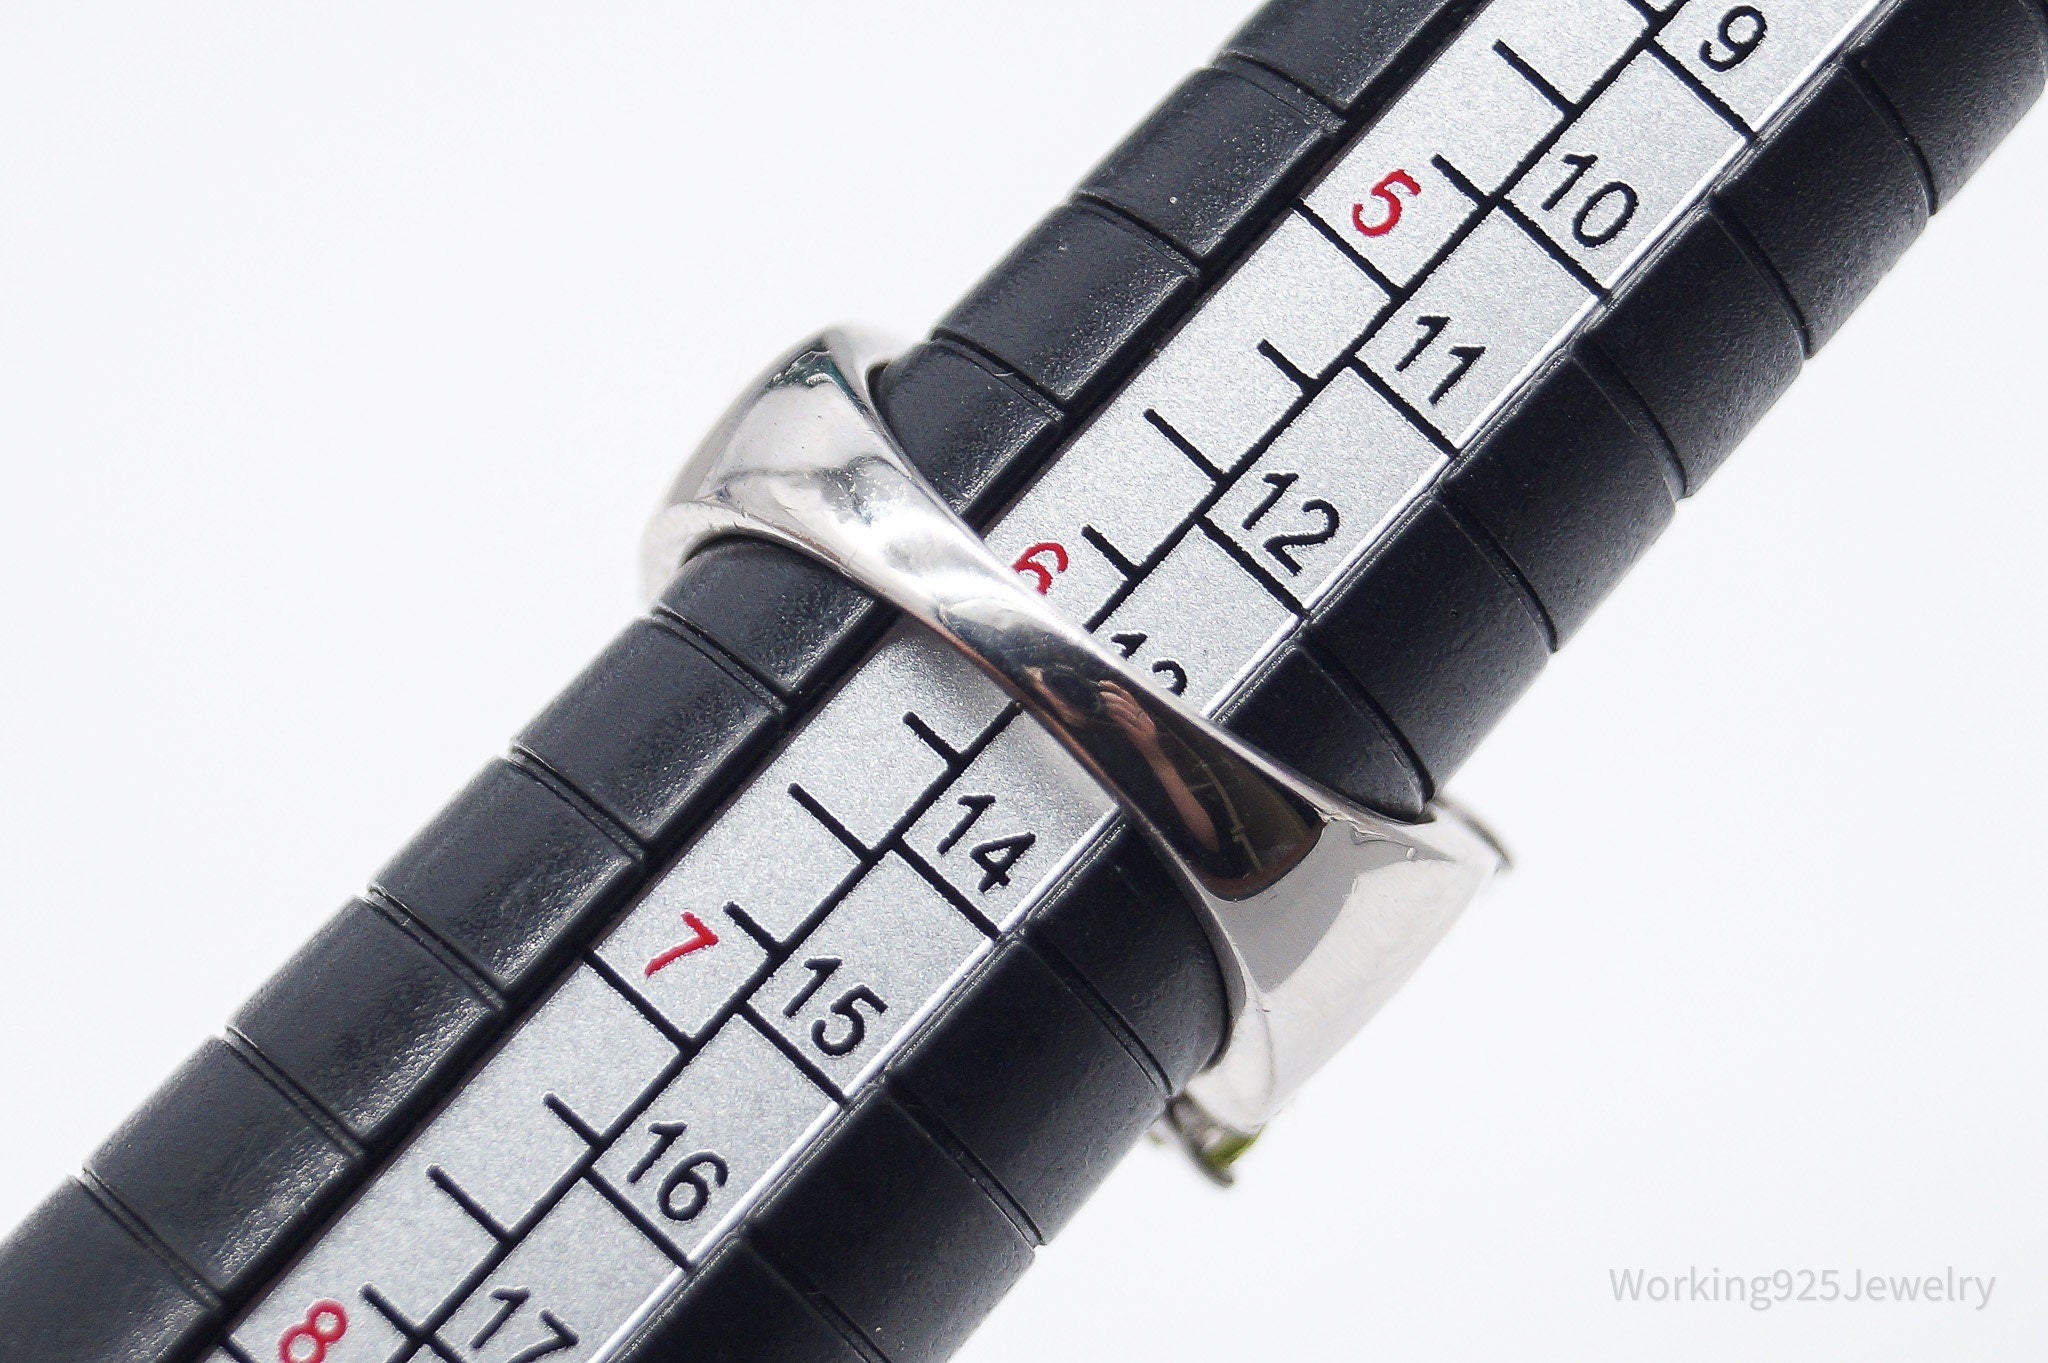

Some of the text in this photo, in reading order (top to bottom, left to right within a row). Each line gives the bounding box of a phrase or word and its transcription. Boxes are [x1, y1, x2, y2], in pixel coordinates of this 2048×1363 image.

[1698, 4, 1769, 74] 9
[1351, 168, 1423, 238] 5
[1540, 152, 1641, 250] 10
[1394, 314, 1487, 408] 11
[1240, 471, 1342, 579] 12
[937, 793, 1038, 896] 14
[645, 912, 720, 977] 7
[782, 957, 890, 1058] 15
[627, 1121, 730, 1223] 16
[278, 1299, 349, 1363] 8
[471, 1288, 581, 1363] 17
